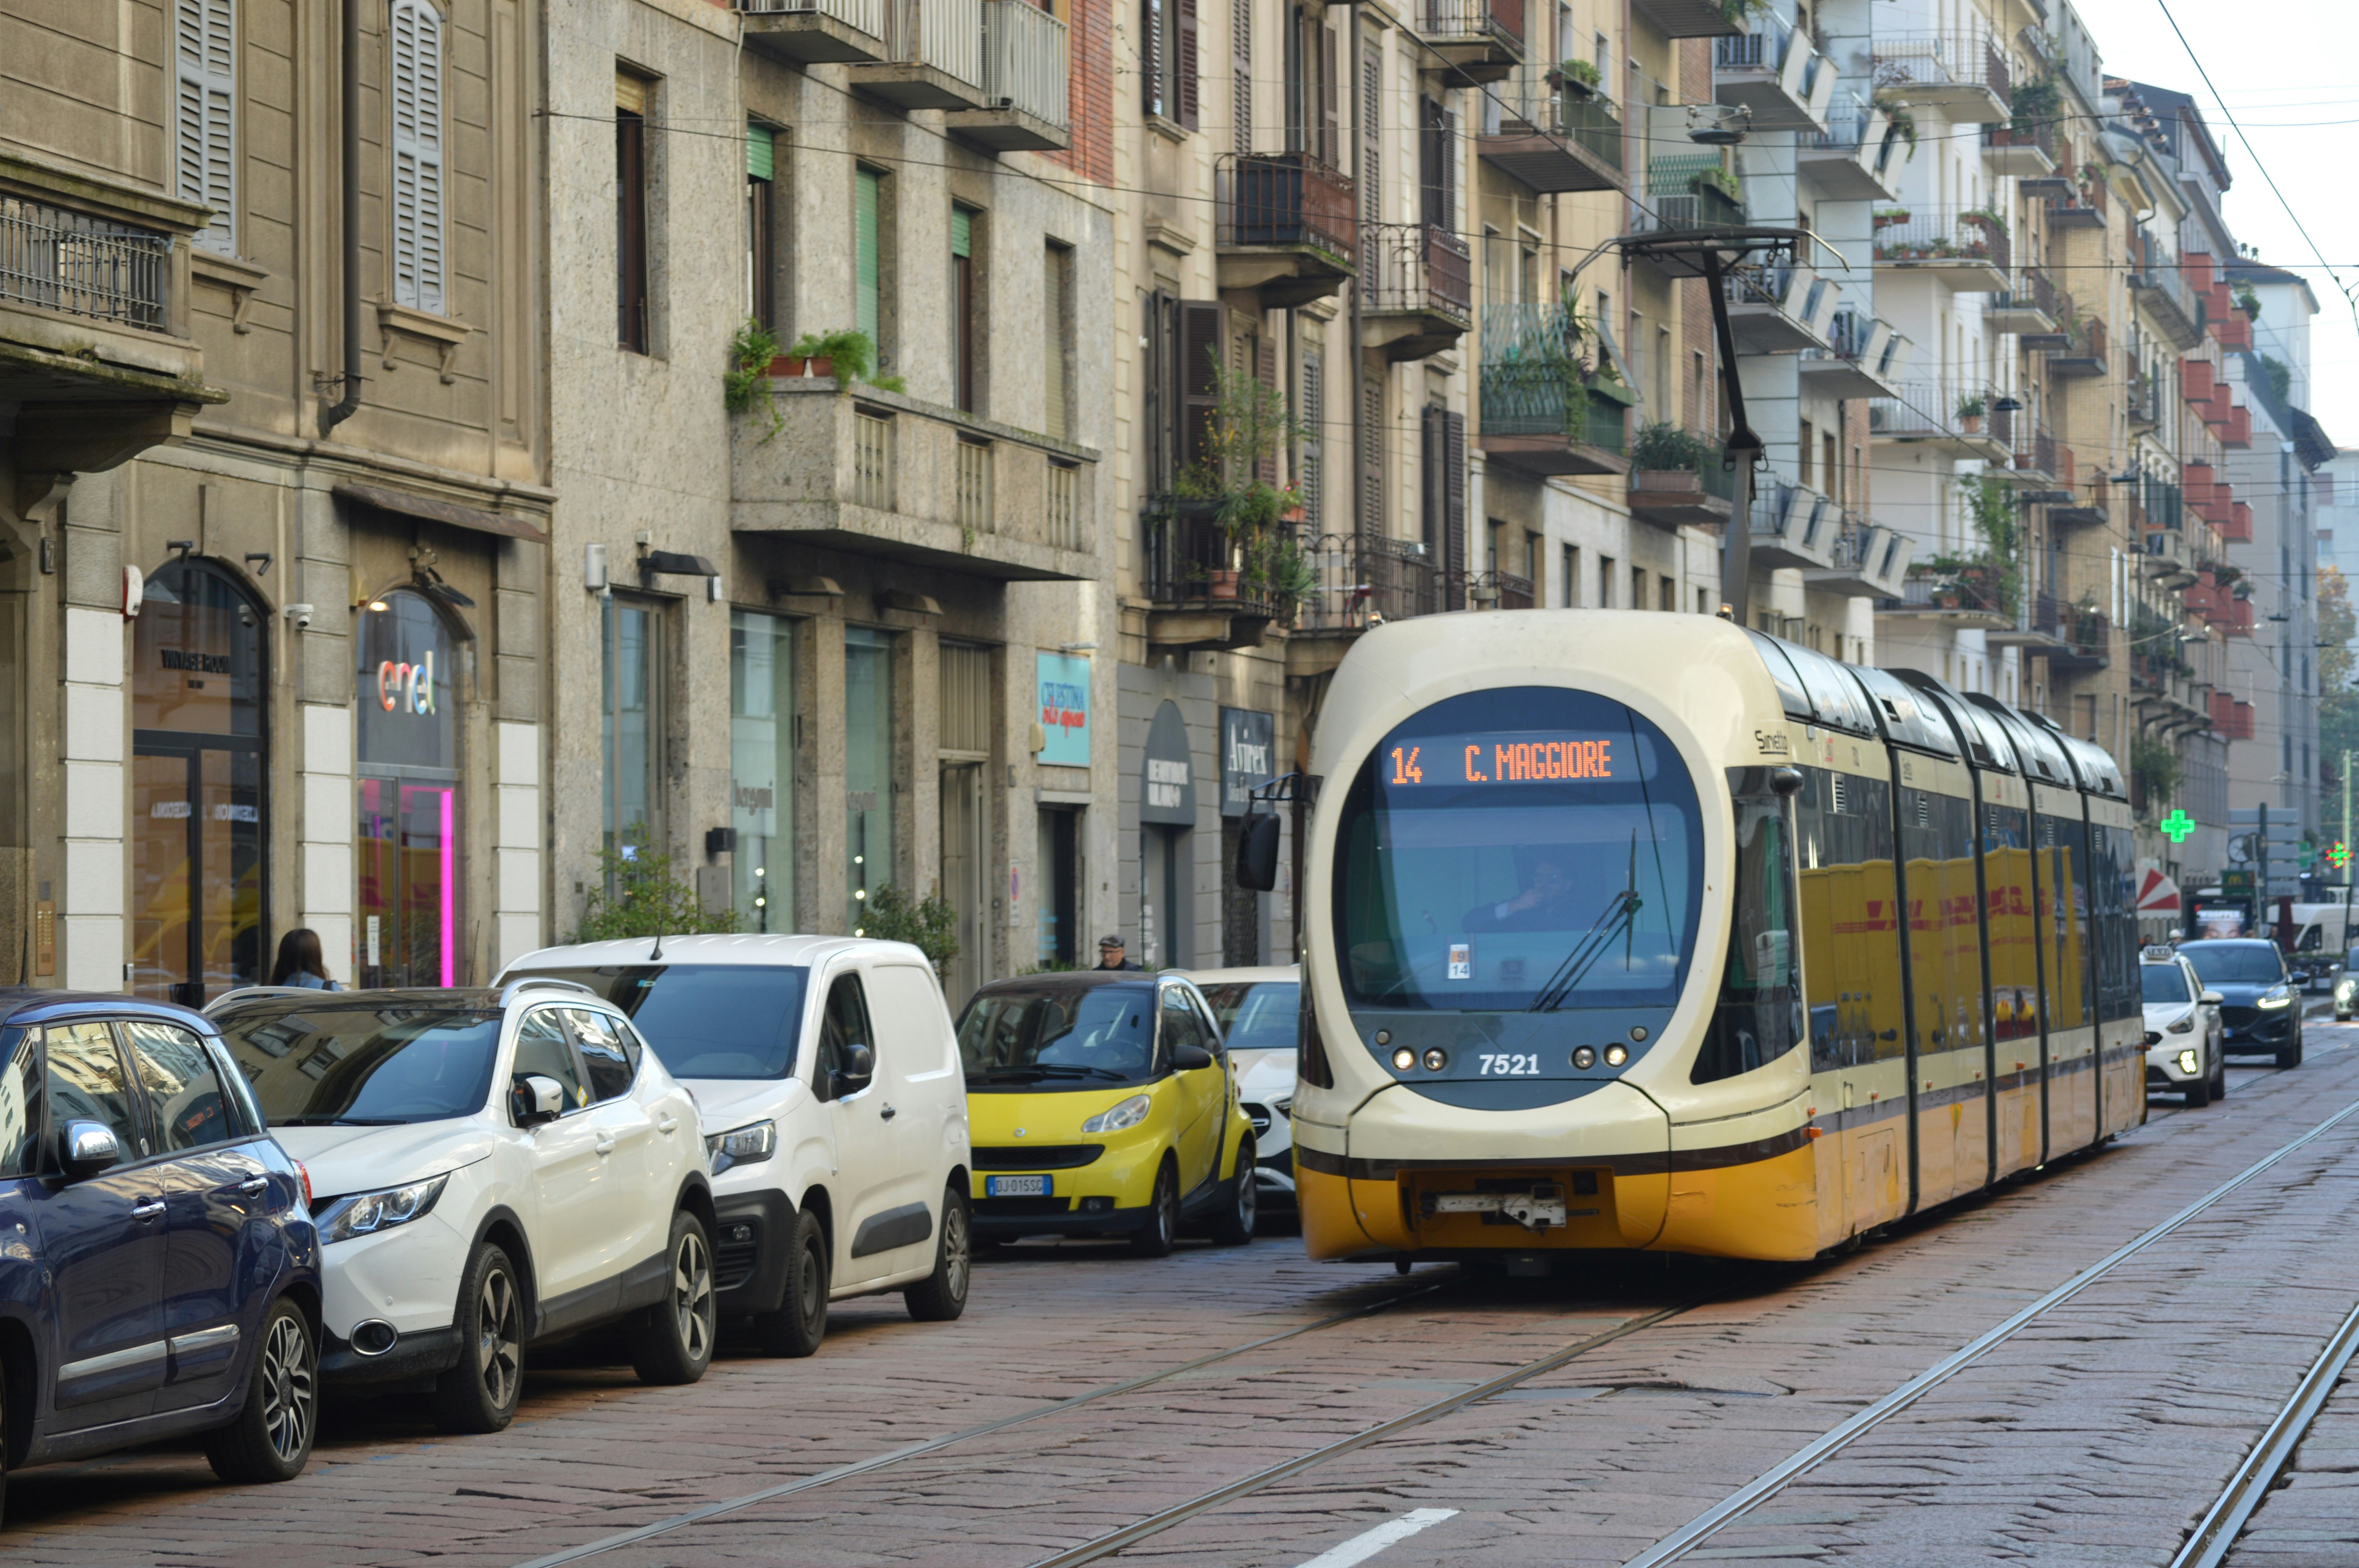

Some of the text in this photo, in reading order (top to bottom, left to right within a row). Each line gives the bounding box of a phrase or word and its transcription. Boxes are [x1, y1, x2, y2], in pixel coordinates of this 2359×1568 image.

[161, 649, 201, 671] VINTAGE
[378, 650, 436, 715] enel
[1041, 681, 1085, 710] CELESTINA
[1228, 723, 1267, 775] Avirex
[1392, 740, 1611, 784] 14 C. MAGGIORE
[1457, 951, 1465, 962] 9
[1452, 964, 1468, 975] 14
[1479, 1054, 1540, 1075] 7521
